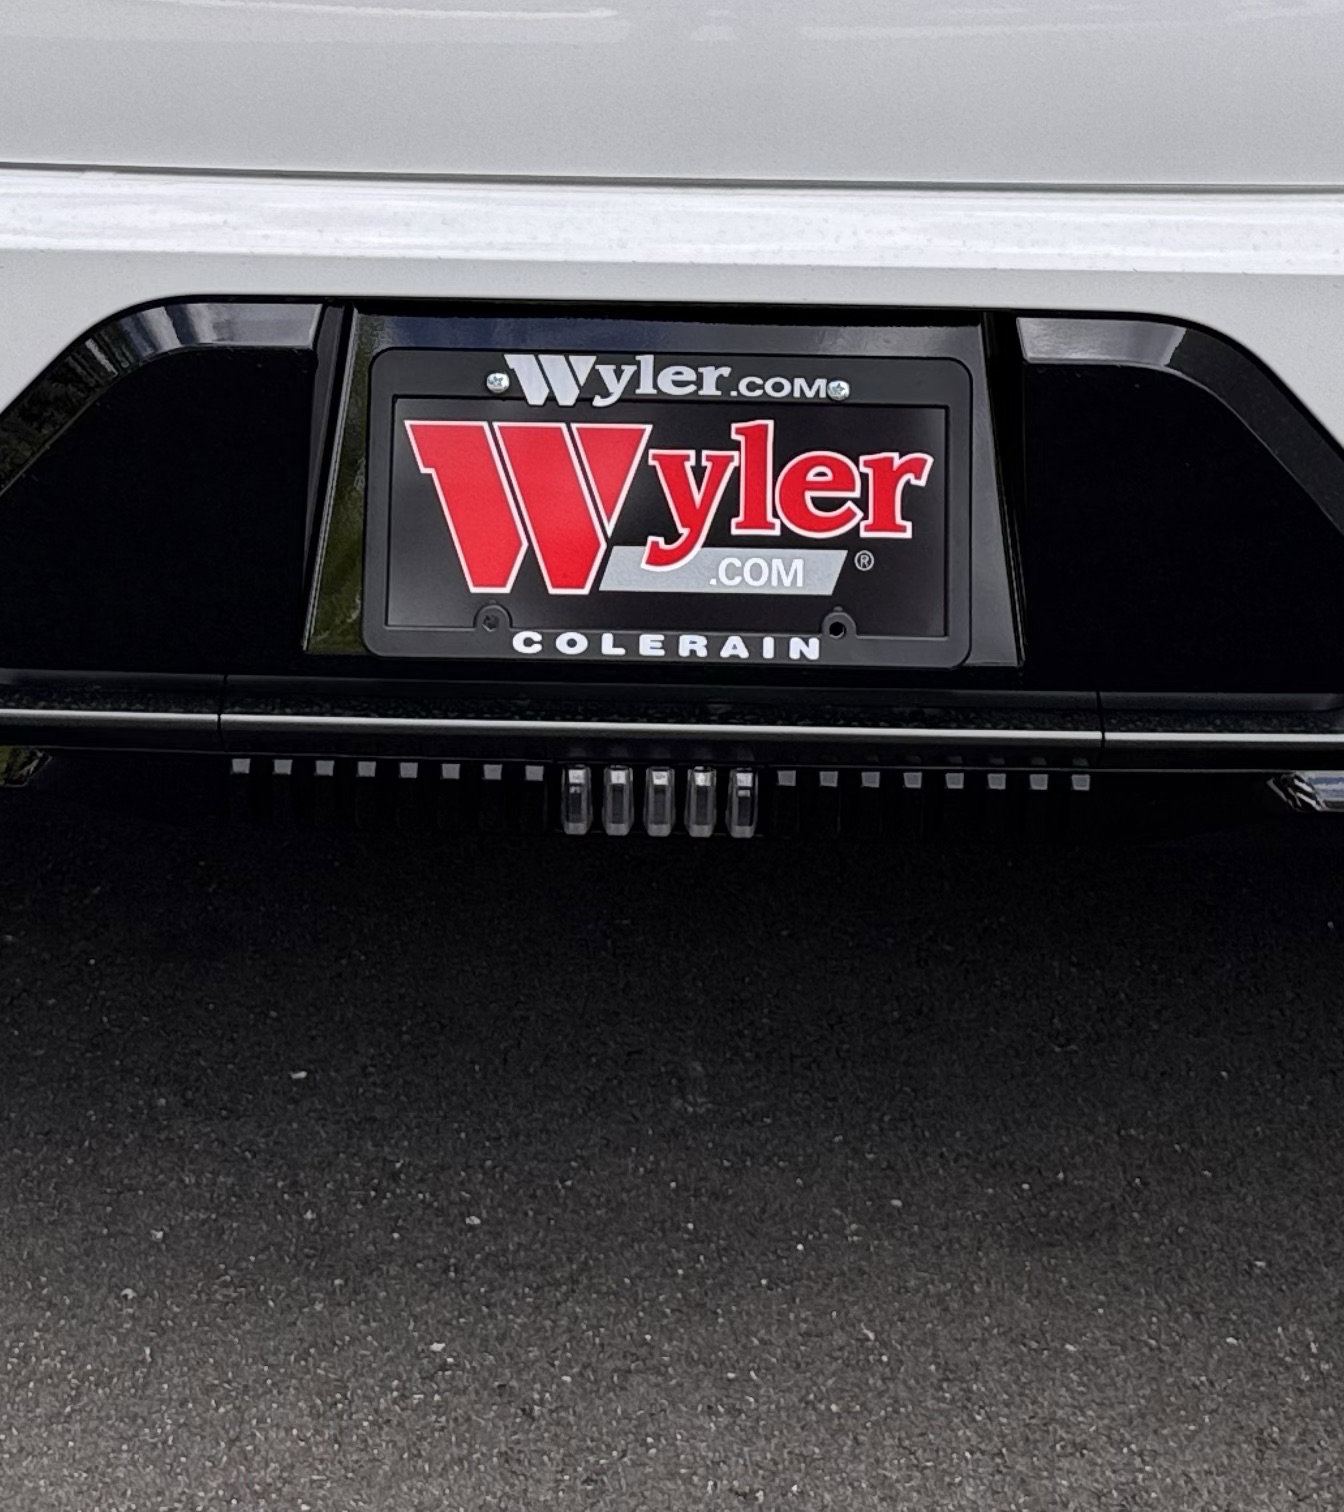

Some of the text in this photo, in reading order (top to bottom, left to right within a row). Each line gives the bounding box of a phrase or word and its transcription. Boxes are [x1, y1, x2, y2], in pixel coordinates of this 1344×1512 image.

[404, 420, 932, 595] Wyler
[709, 557, 804, 587] .COM
[512, 631, 820, 660] COLERAIN
